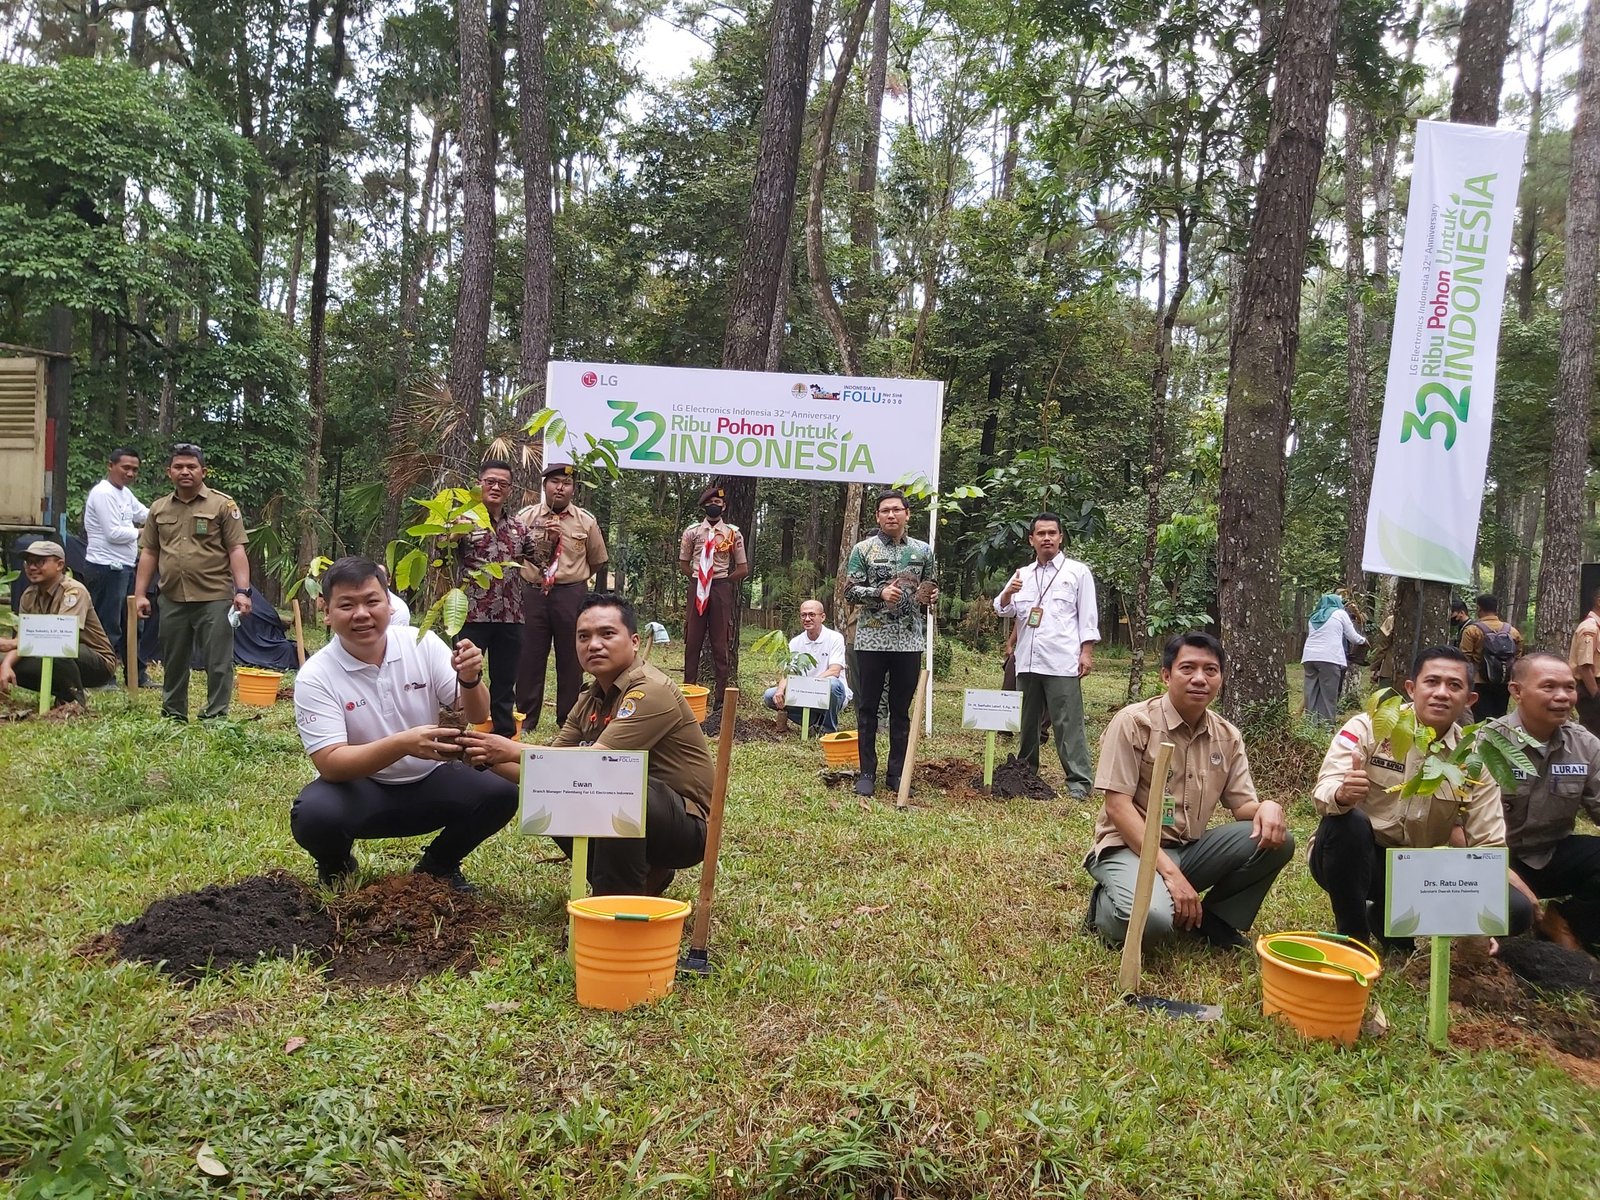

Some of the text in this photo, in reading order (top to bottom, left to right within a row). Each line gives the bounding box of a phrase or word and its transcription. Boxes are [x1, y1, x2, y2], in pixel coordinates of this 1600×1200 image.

[1425, 203, 1440, 254] Anniversary
[1442, 172, 1498, 382] INDONESIA
[1418, 274, 1431, 314] Indonesia
[1420, 208, 1459, 377] Ribu Pohon Untuk
[1411, 315, 1424, 362] Electronics
[600, 375, 618, 387] LG
[1409, 365, 1418, 376] LG
[842, 390, 882, 404] FOLU
[672, 403, 683, 412] LG
[685, 404, 731, 415] Electronics
[732, 407, 772, 417] Indonesia
[791, 410, 841, 422] Anniversary
[1400, 382, 1472, 451] 32
[601, 400, 667, 462] 32
[671, 414, 838, 440] Ribu Pohon Untuk
[669, 432, 875, 474] INDONESIA
[356, 699, 366, 708] LG
[305, 714, 317, 725] LG
[1553, 765, 1585, 774] LURAH
[572, 780, 593, 788] Ewan
[1424, 879, 1478, 887] Drs. Ratu Dewa
